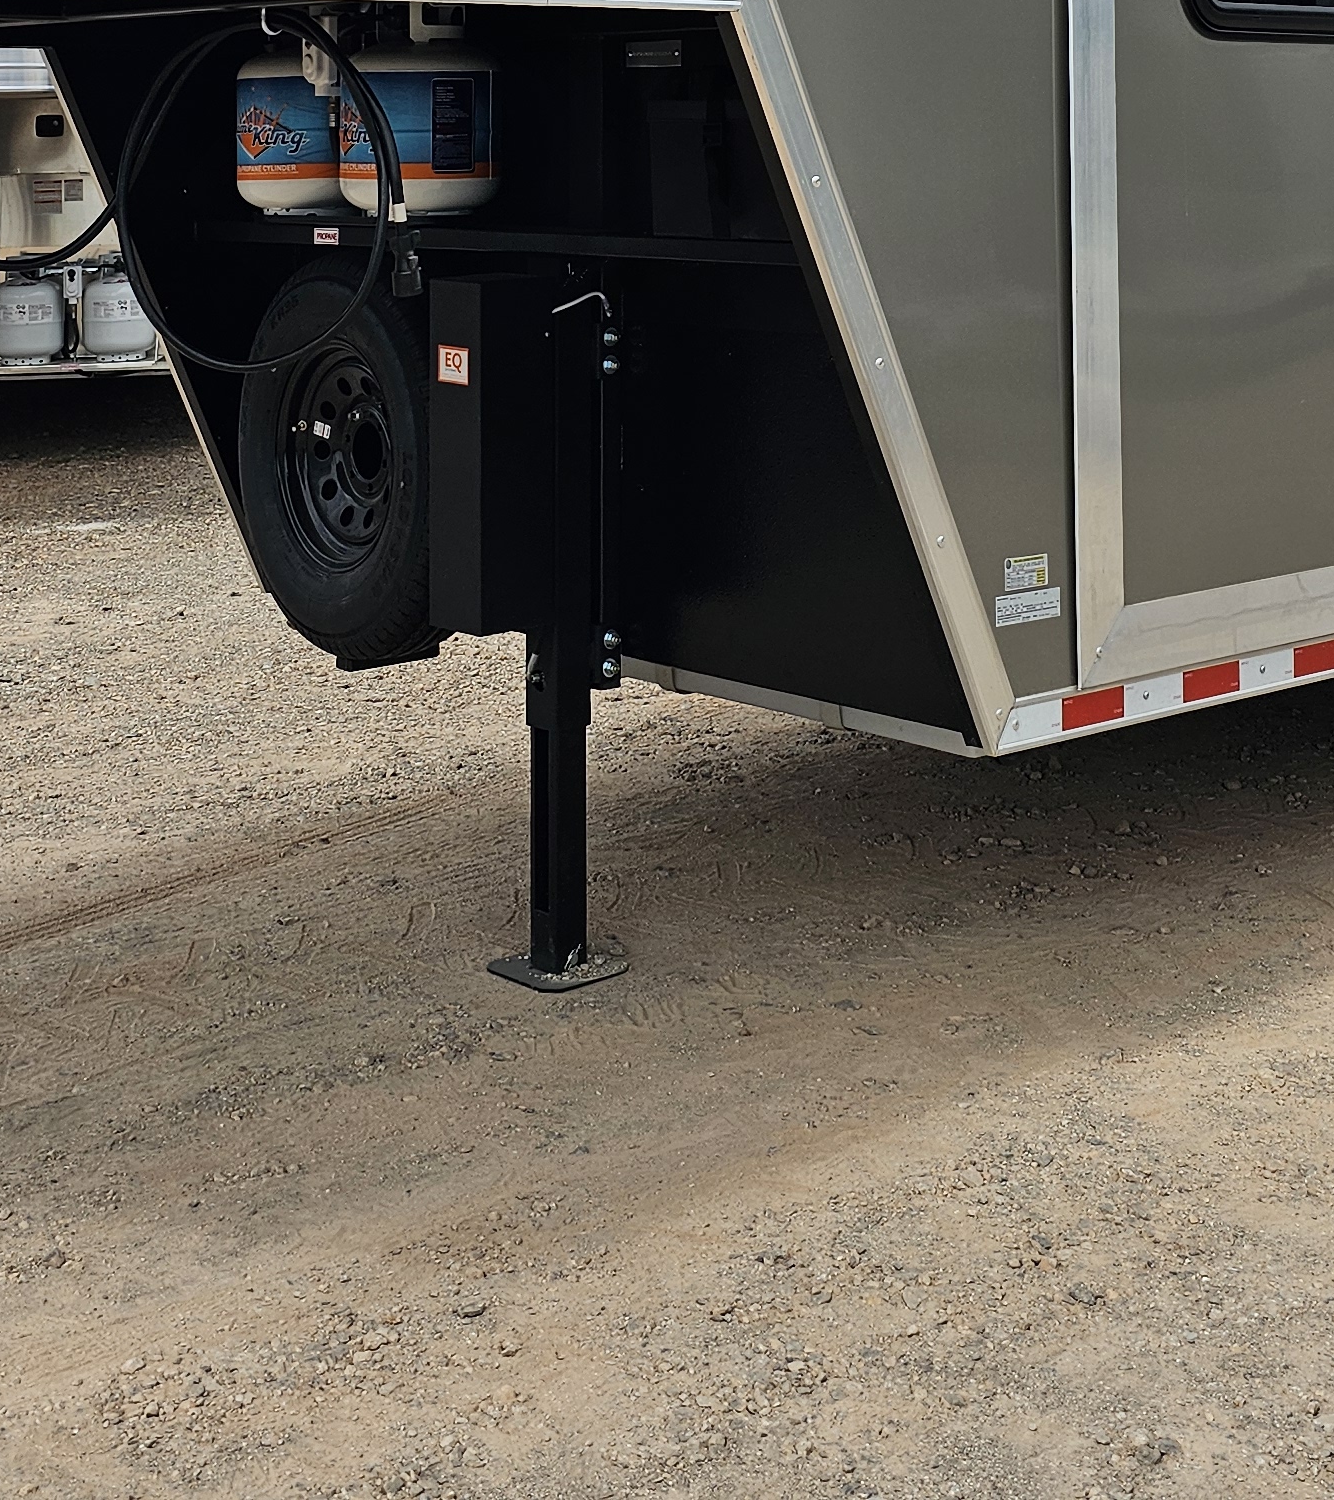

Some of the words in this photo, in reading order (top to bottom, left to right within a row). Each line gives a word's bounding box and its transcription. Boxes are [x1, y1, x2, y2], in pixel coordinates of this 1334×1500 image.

[250, 124, 310, 155] King
[341, 121, 375, 155] Kin
[262, 164, 297, 173] CYLINDER
[445, 351, 462, 374] EQ
